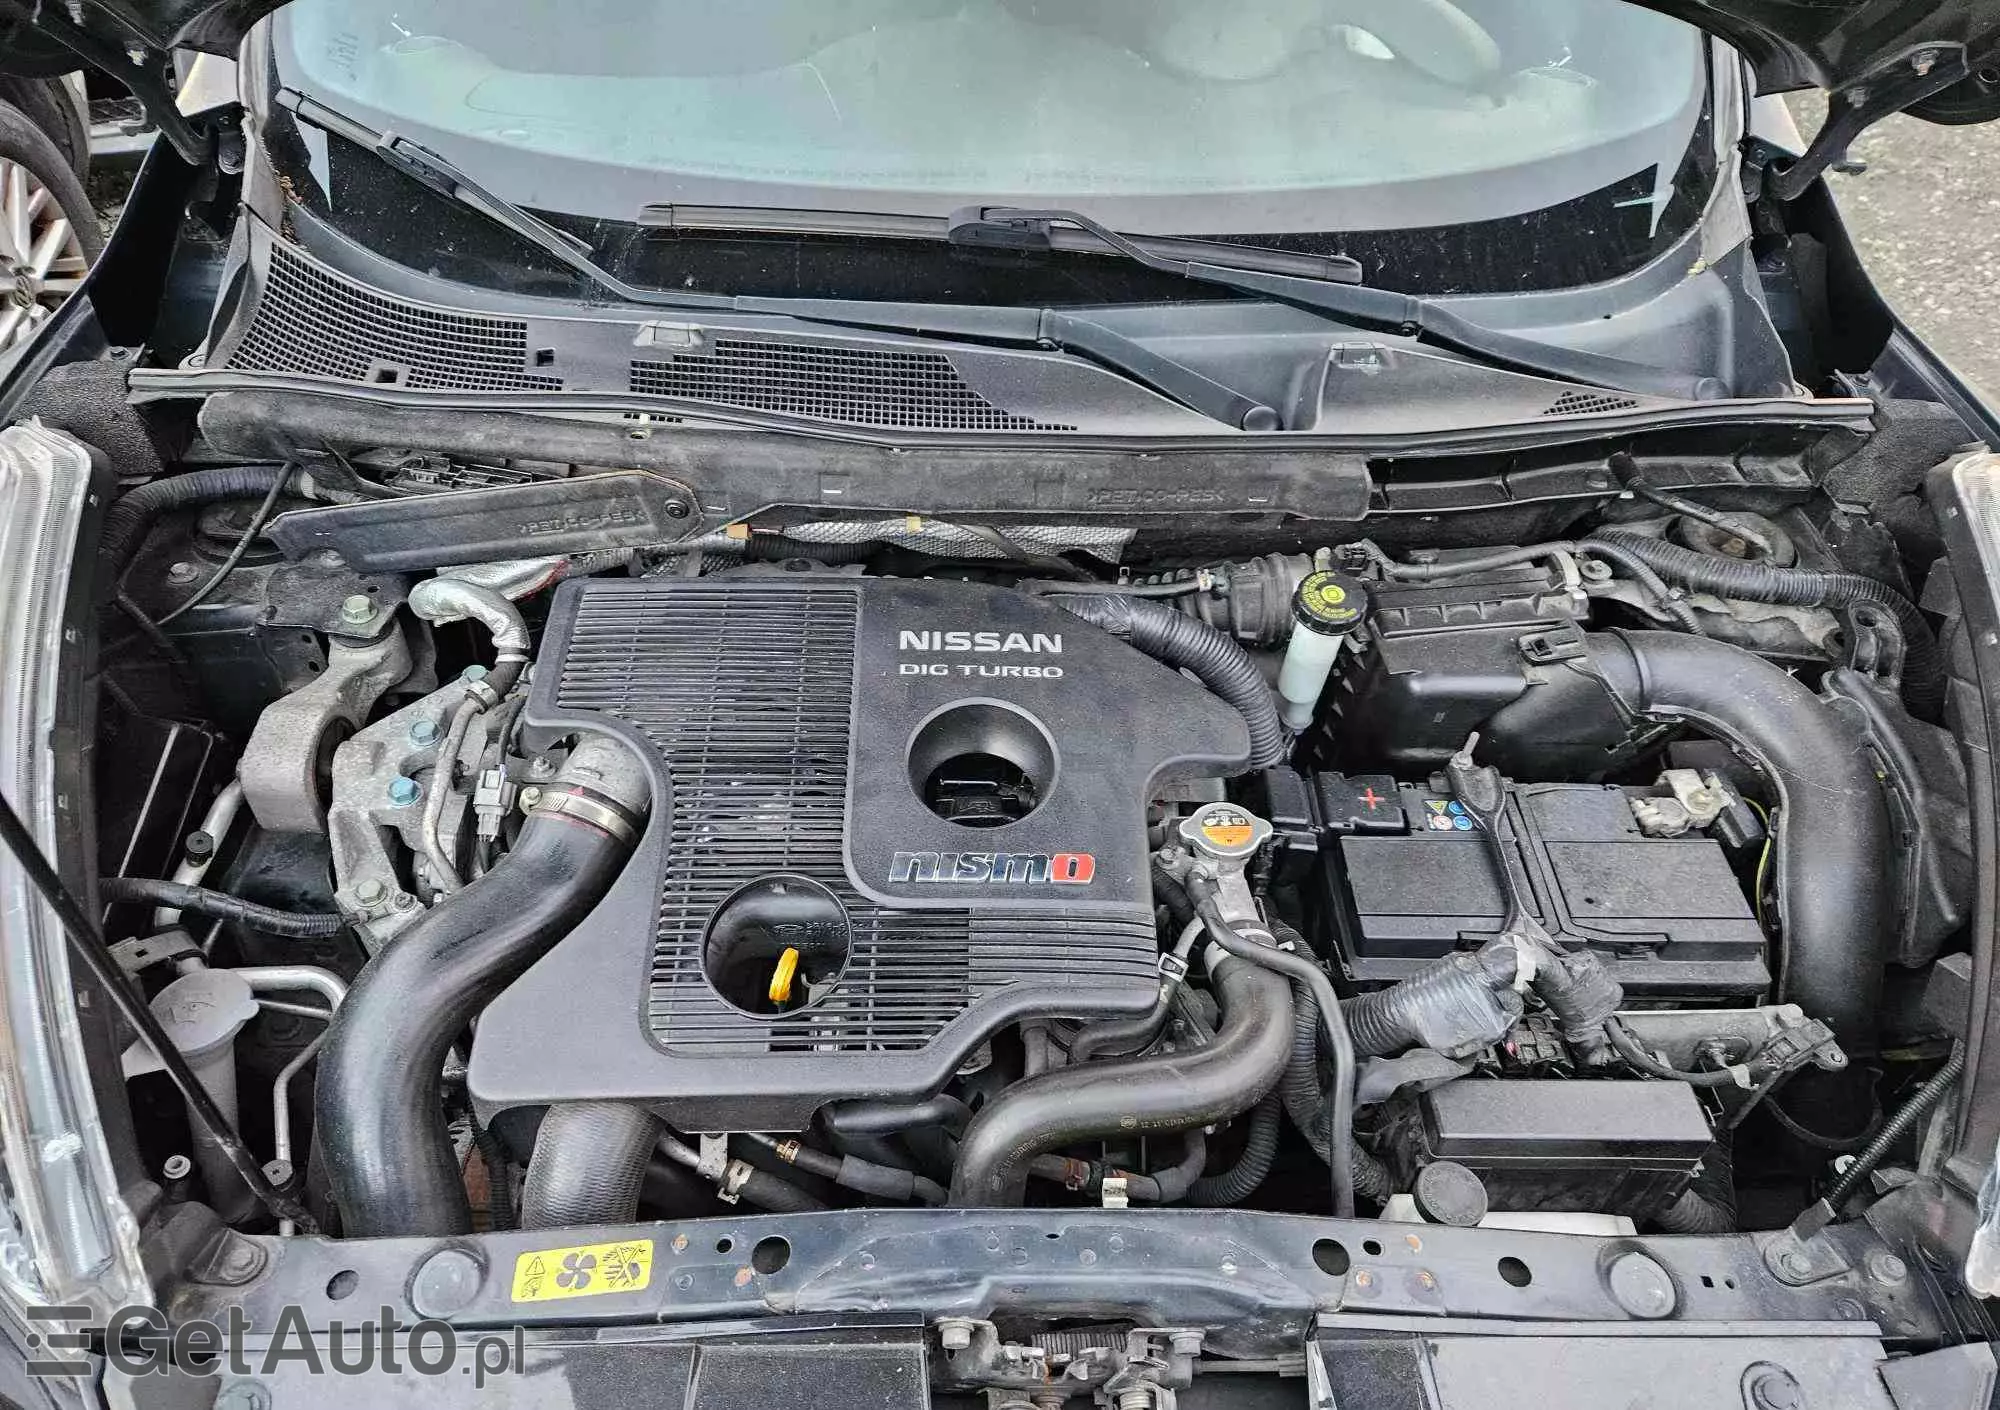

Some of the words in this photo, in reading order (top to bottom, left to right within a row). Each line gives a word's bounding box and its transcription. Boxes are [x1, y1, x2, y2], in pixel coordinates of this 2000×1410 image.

[899, 630, 1063, 654] NISSAN
[899, 663, 950, 677] DIG
[957, 664, 1064, 679] TURBO
